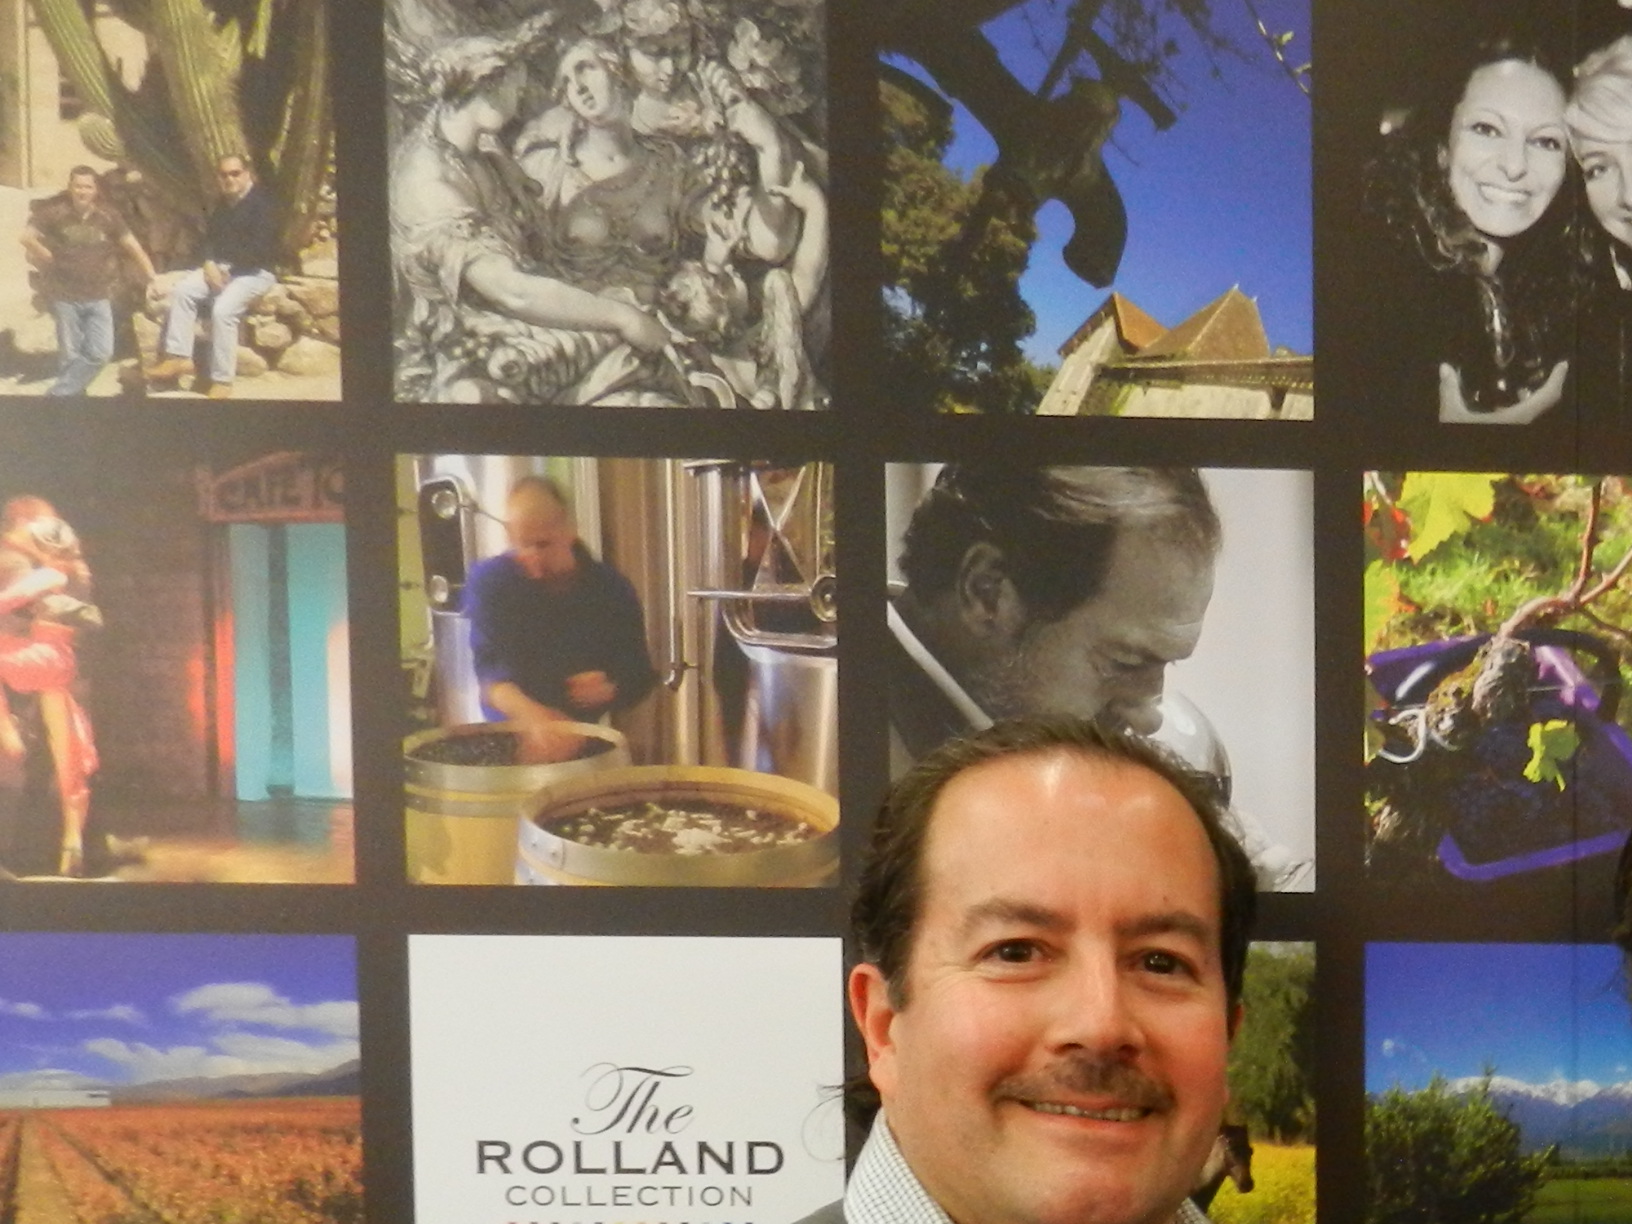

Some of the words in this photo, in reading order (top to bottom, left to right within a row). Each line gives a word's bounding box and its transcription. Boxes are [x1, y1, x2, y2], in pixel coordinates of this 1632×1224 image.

[570, 1061, 695, 1135] The
[475, 1139, 786, 1176] ROLLAND
[504, 1185, 754, 1207] COLLECTION
